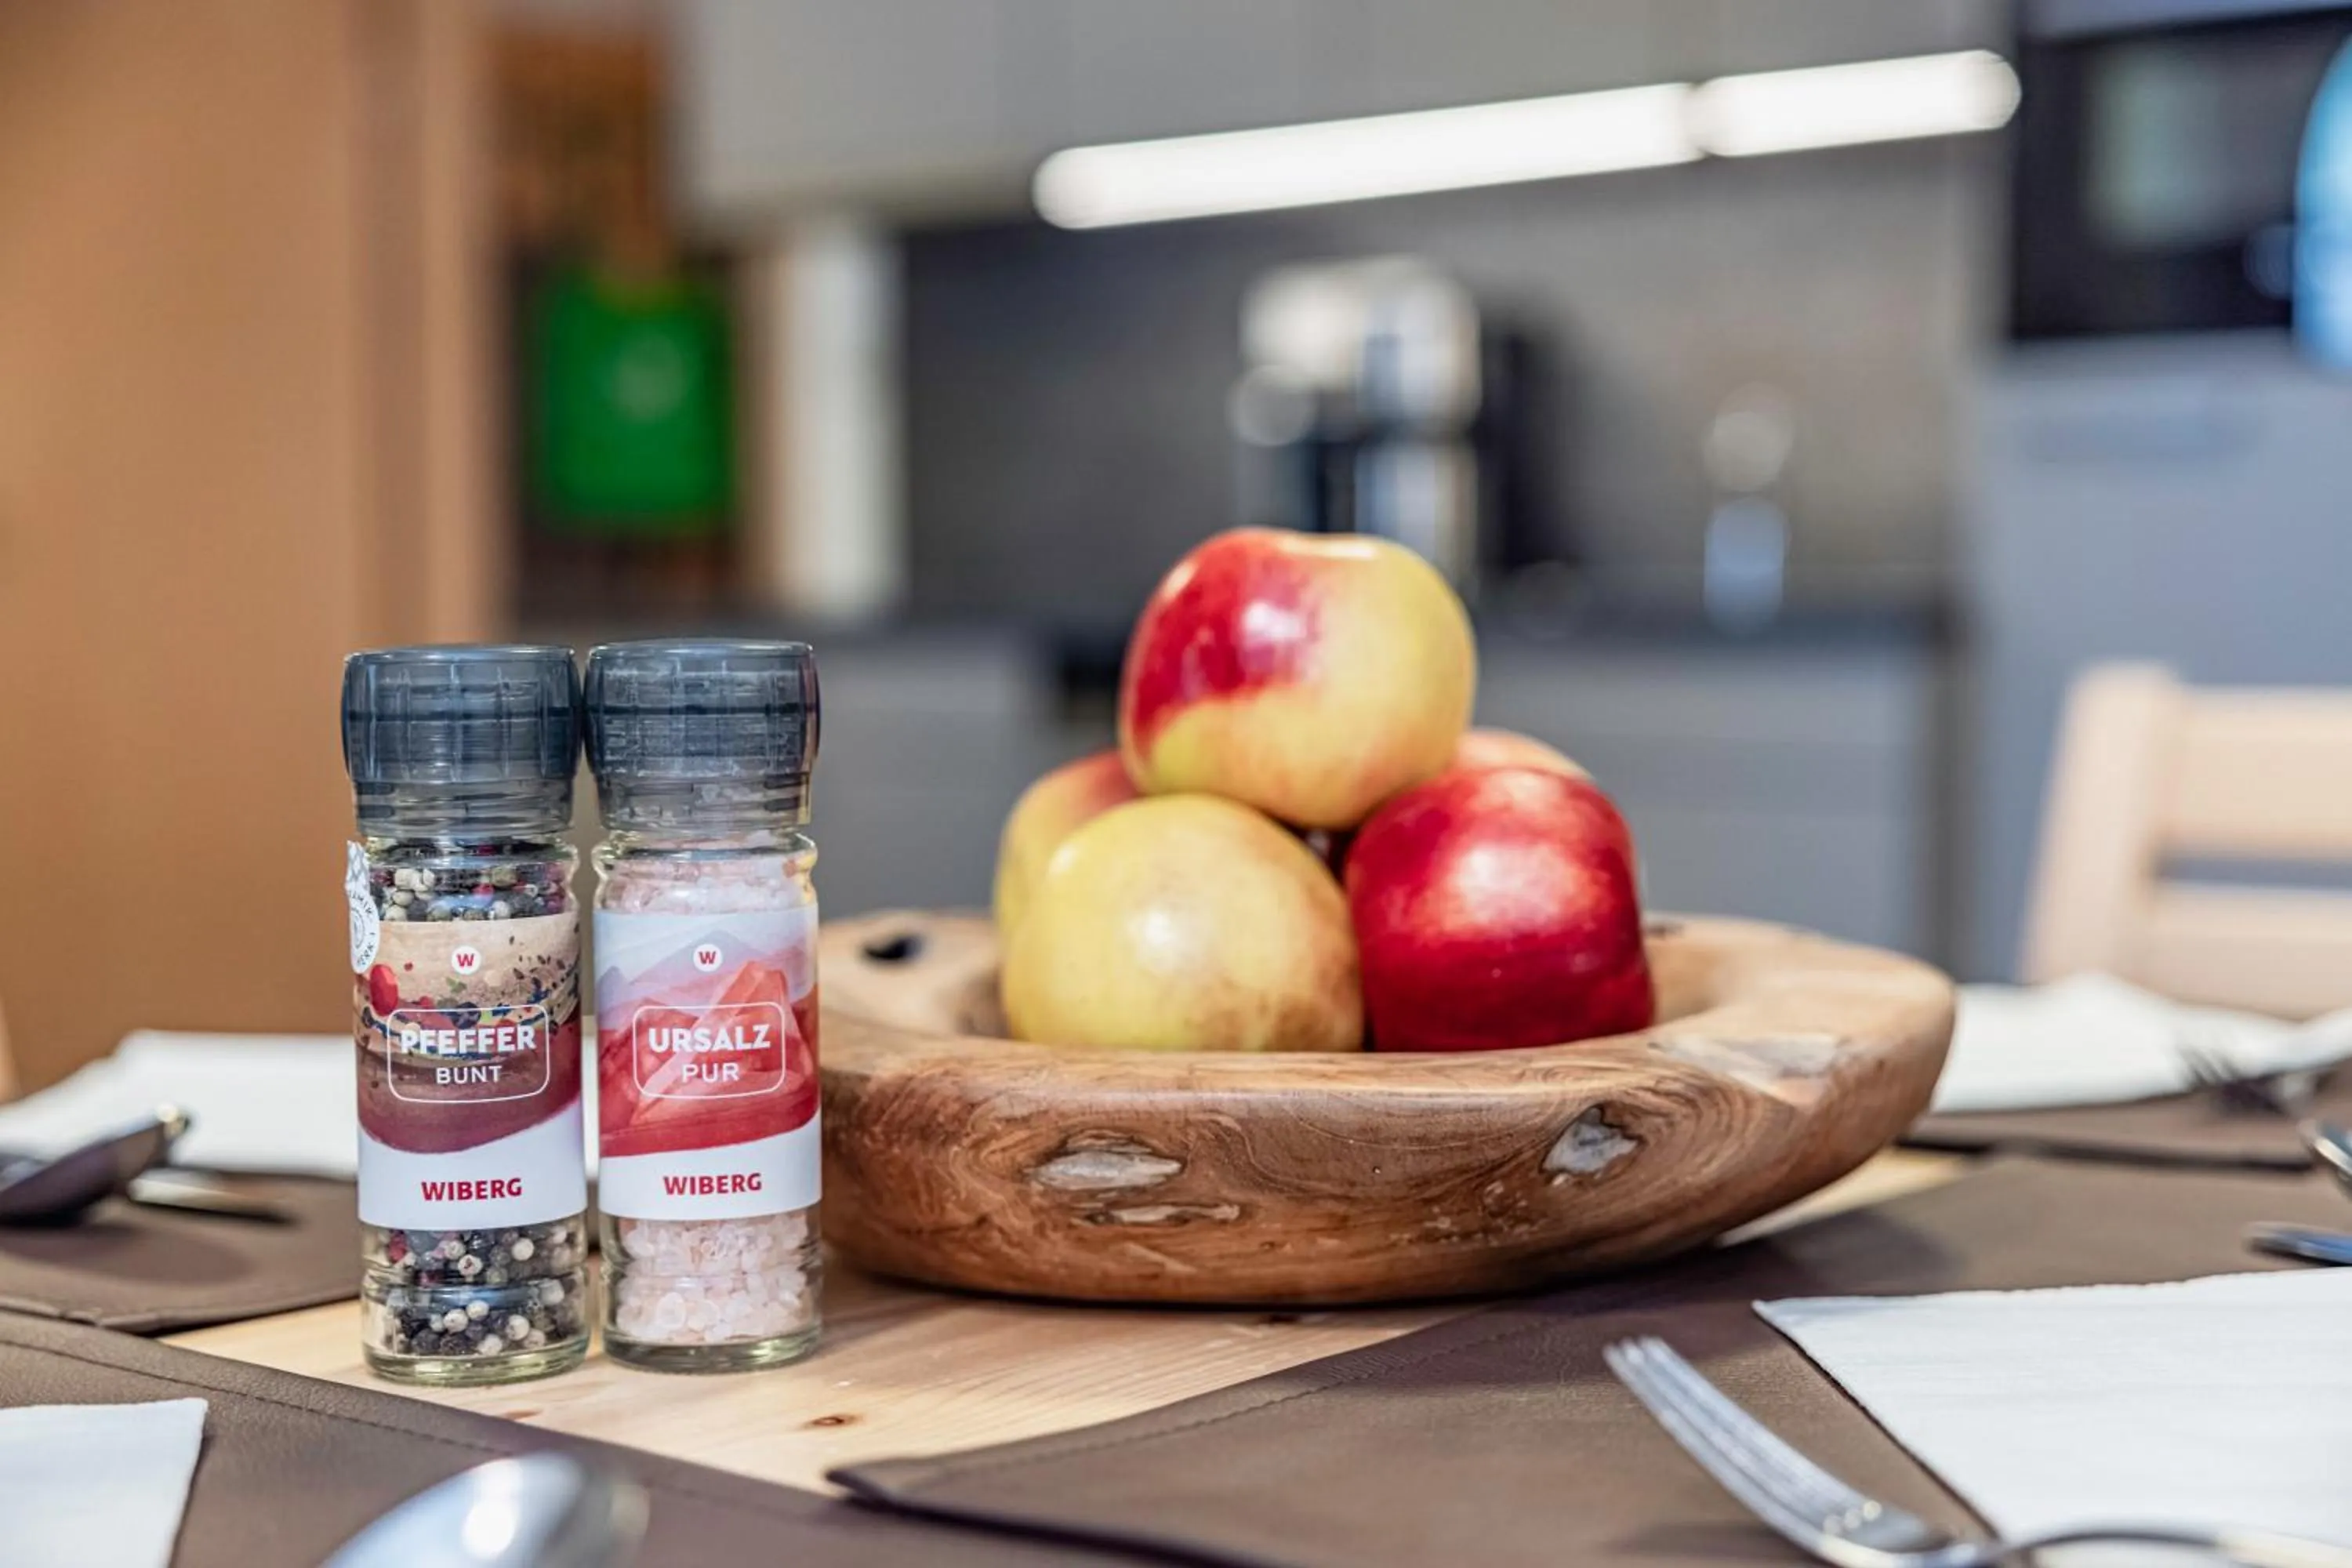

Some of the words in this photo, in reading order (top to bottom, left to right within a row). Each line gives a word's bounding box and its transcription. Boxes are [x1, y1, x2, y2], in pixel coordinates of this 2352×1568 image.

[457, 953, 474, 967] W
[699, 950, 717, 964] W
[401, 1025, 536, 1054] PFEFFER
[648, 1024, 771, 1053] URSALZ
[436, 1065, 502, 1084] BUNT
[681, 1062, 739, 1083] PUR
[421, 1178, 522, 1201] WIBERG
[663, 1173, 762, 1196] WIBERG
